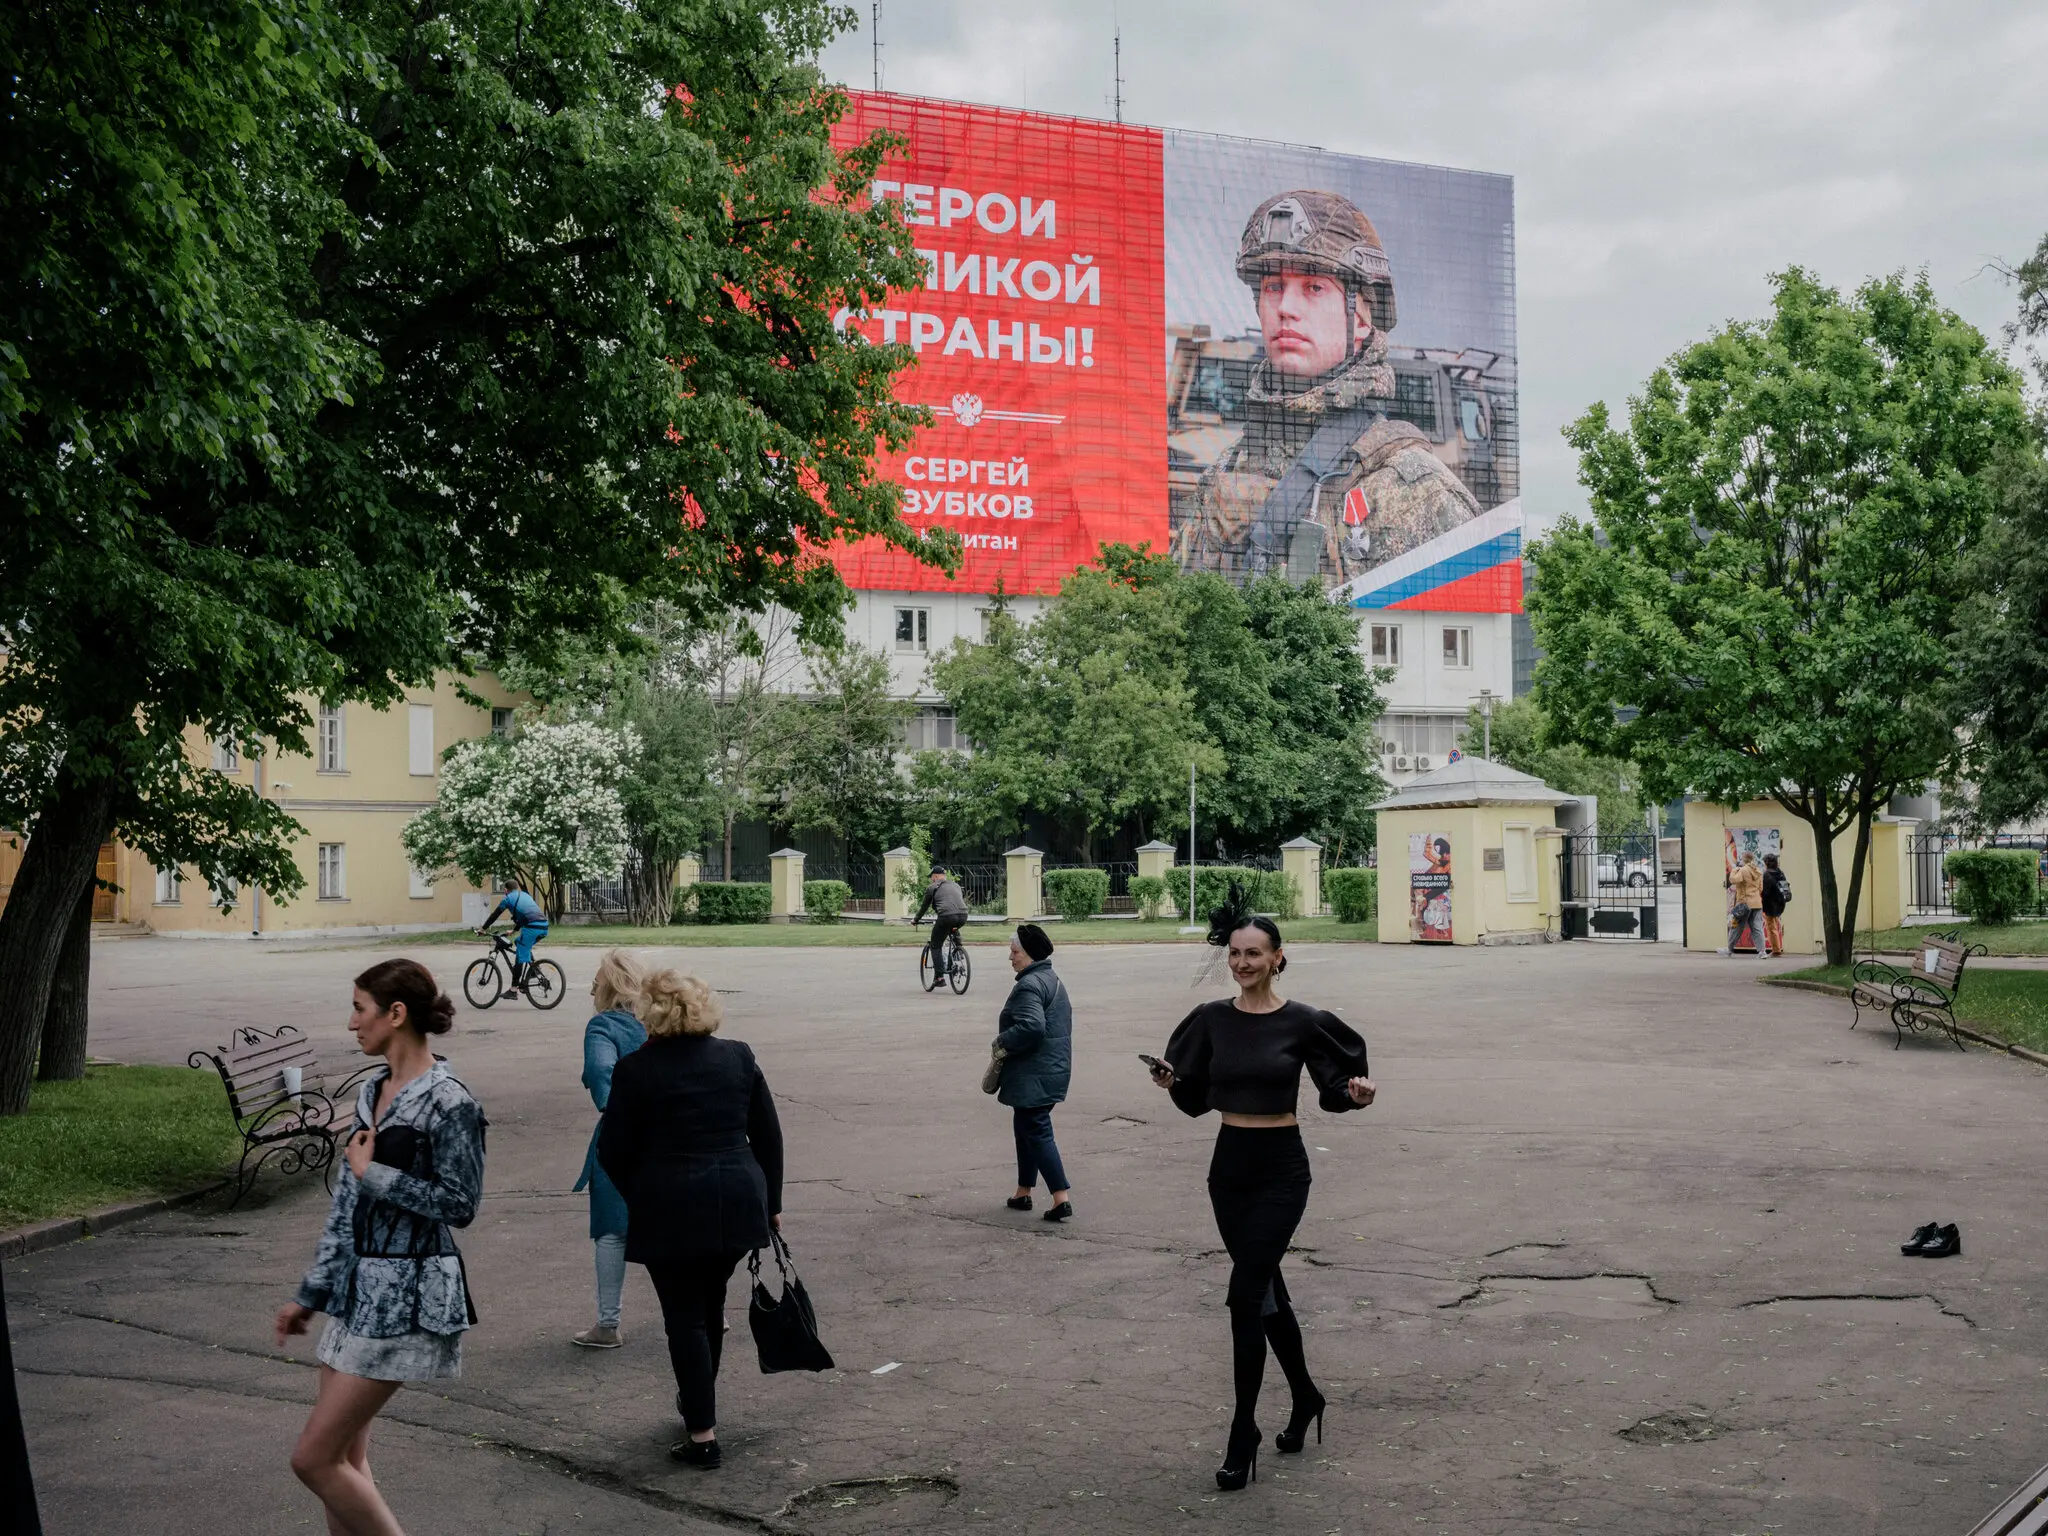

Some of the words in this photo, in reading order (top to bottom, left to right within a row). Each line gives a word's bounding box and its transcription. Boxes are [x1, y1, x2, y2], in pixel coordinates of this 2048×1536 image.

[872, 180, 1056, 239] ГЕРОИ
[860, 247, 1101, 306] ЛИКОЙ
[833, 306, 1095, 368] СТРАНЫ!
[905, 456, 1029, 487] СЕРГЕЙ
[902, 489, 1034, 519] ЗУБКОВ
